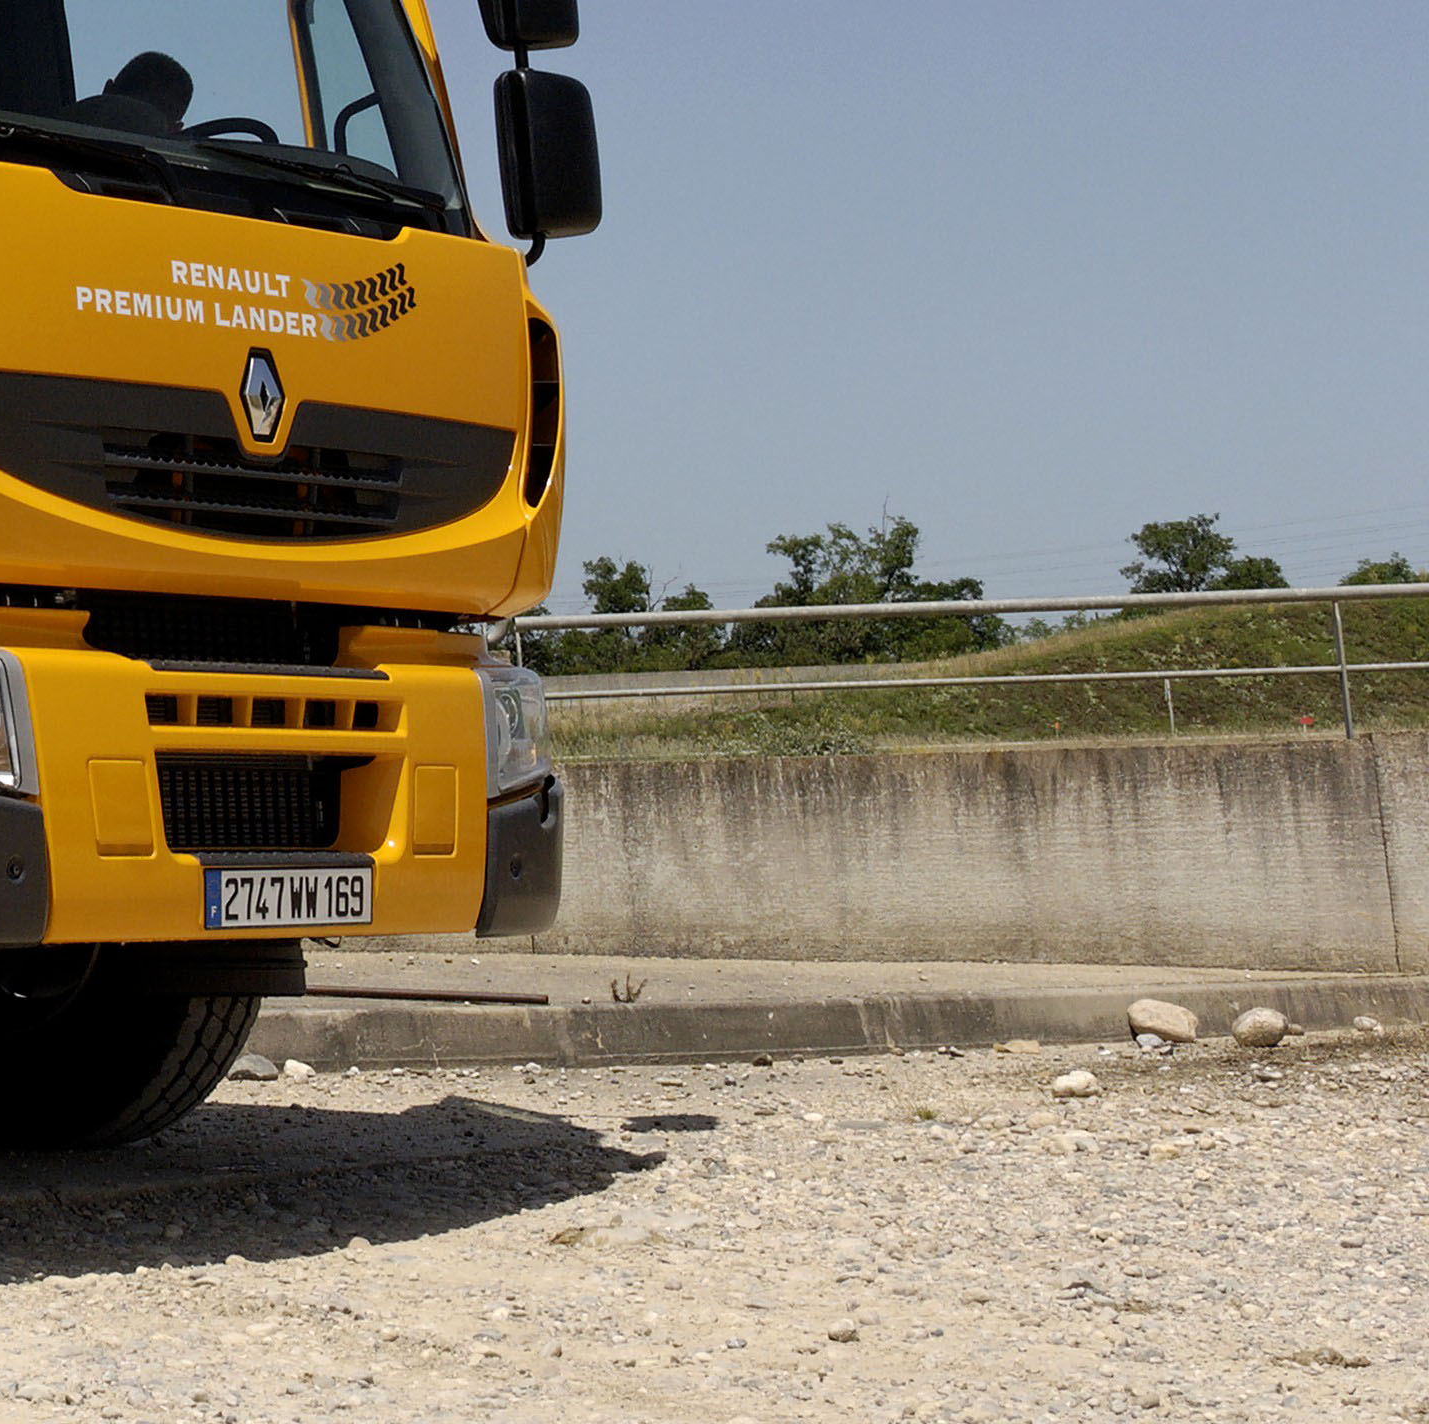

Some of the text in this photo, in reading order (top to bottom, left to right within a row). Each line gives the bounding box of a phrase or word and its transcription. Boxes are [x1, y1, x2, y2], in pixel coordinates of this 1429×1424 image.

[171, 260, 291, 299] RENAULT
[75, 286, 318, 339] PREMIUM LANDER
[210, 875, 364, 921] F 2747 WW 169
